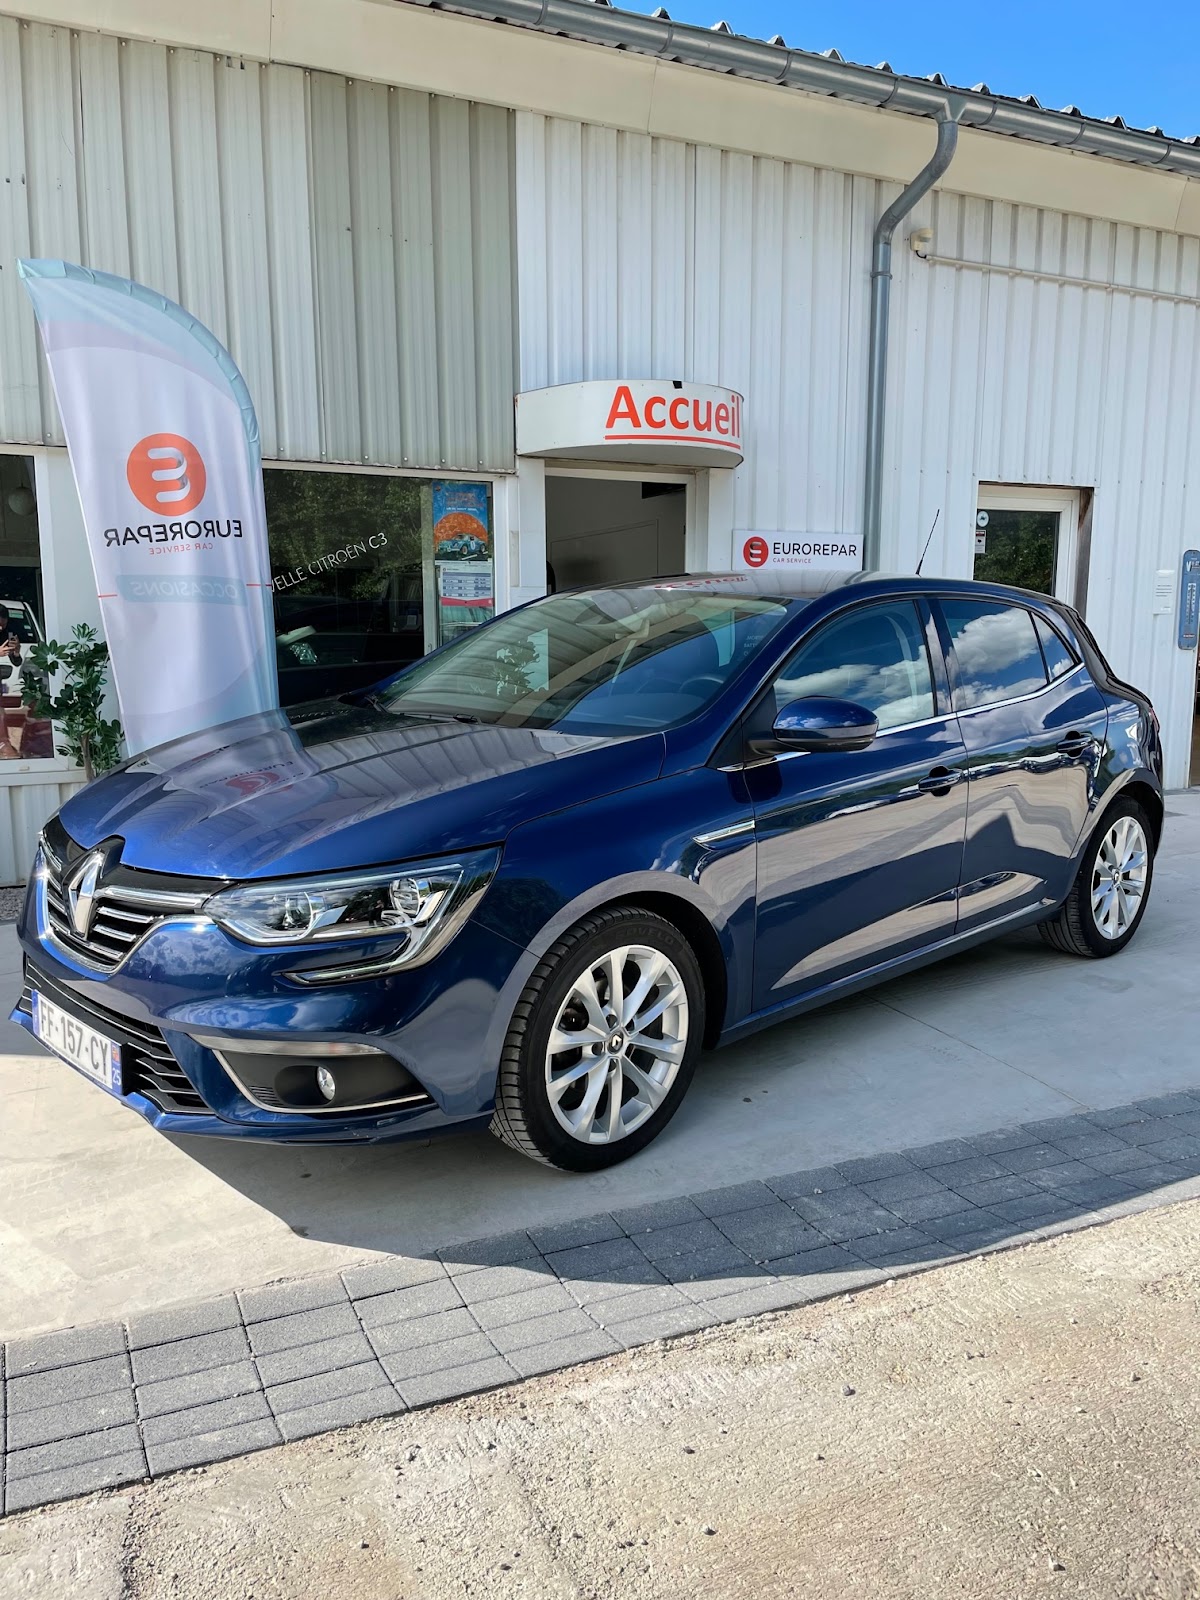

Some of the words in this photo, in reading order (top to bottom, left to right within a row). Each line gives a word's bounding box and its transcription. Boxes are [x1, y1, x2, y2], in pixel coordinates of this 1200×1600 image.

[605, 385, 740, 438] Accueil
[308, 541, 367, 575] CITROËN
[368, 532, 388, 549] C3
[773, 542, 857, 556] EUROREPAR
[112, 1067, 122, 1086] 25
